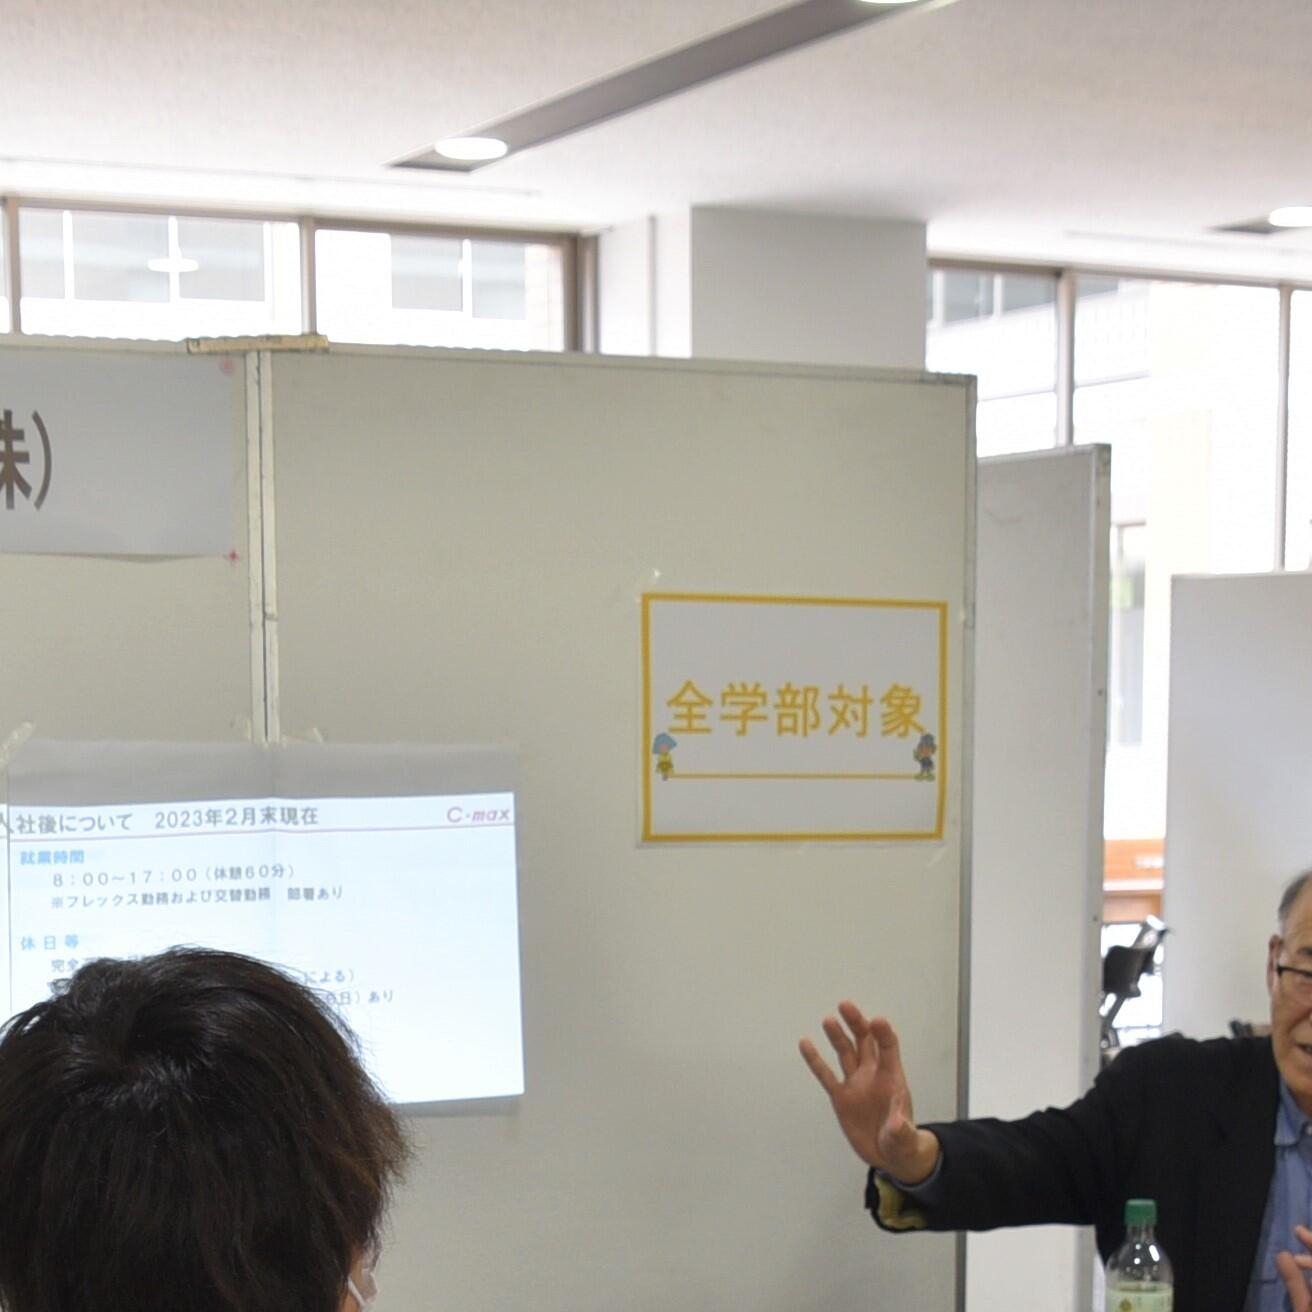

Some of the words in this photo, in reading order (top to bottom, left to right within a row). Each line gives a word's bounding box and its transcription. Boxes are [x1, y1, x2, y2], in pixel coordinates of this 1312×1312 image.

[666, 679, 926, 739] 全学部対象
[154, 806, 320, 831] 2023年2月末現在
